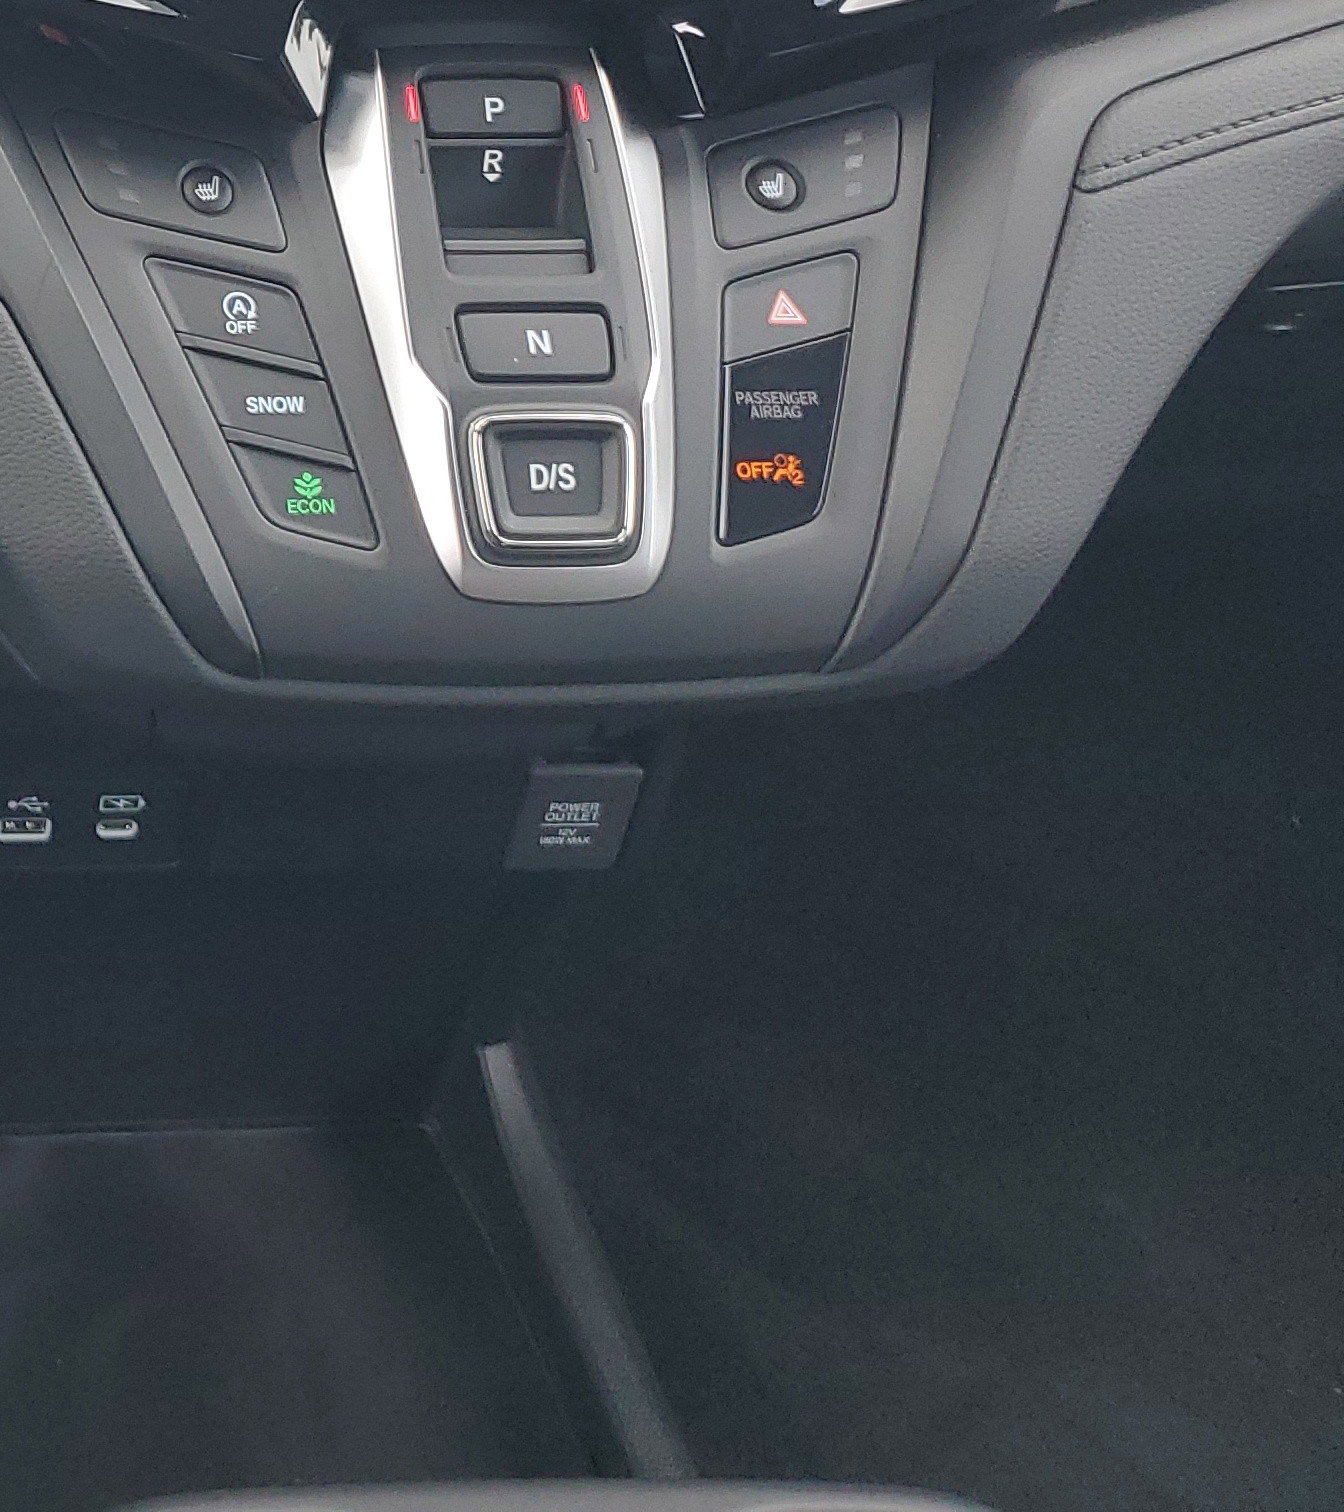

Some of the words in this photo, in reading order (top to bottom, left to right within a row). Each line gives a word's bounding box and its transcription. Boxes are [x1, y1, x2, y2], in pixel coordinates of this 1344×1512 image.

[484, 97, 506, 123] P
[481, 149, 503, 173] R
[225, 319, 258, 335] OFF
[525, 331, 553, 356] N
[245, 396, 305, 414] SNOW
[735, 390, 819, 407] PASSENGER
[749, 404, 802, 419] AIRBAG
[529, 462, 577, 491] D/S
[736, 461, 774, 481] OFF
[286, 498, 336, 515] ECON
[549, 802, 600, 813] POWER
[544, 812, 599, 822] OUTLET
